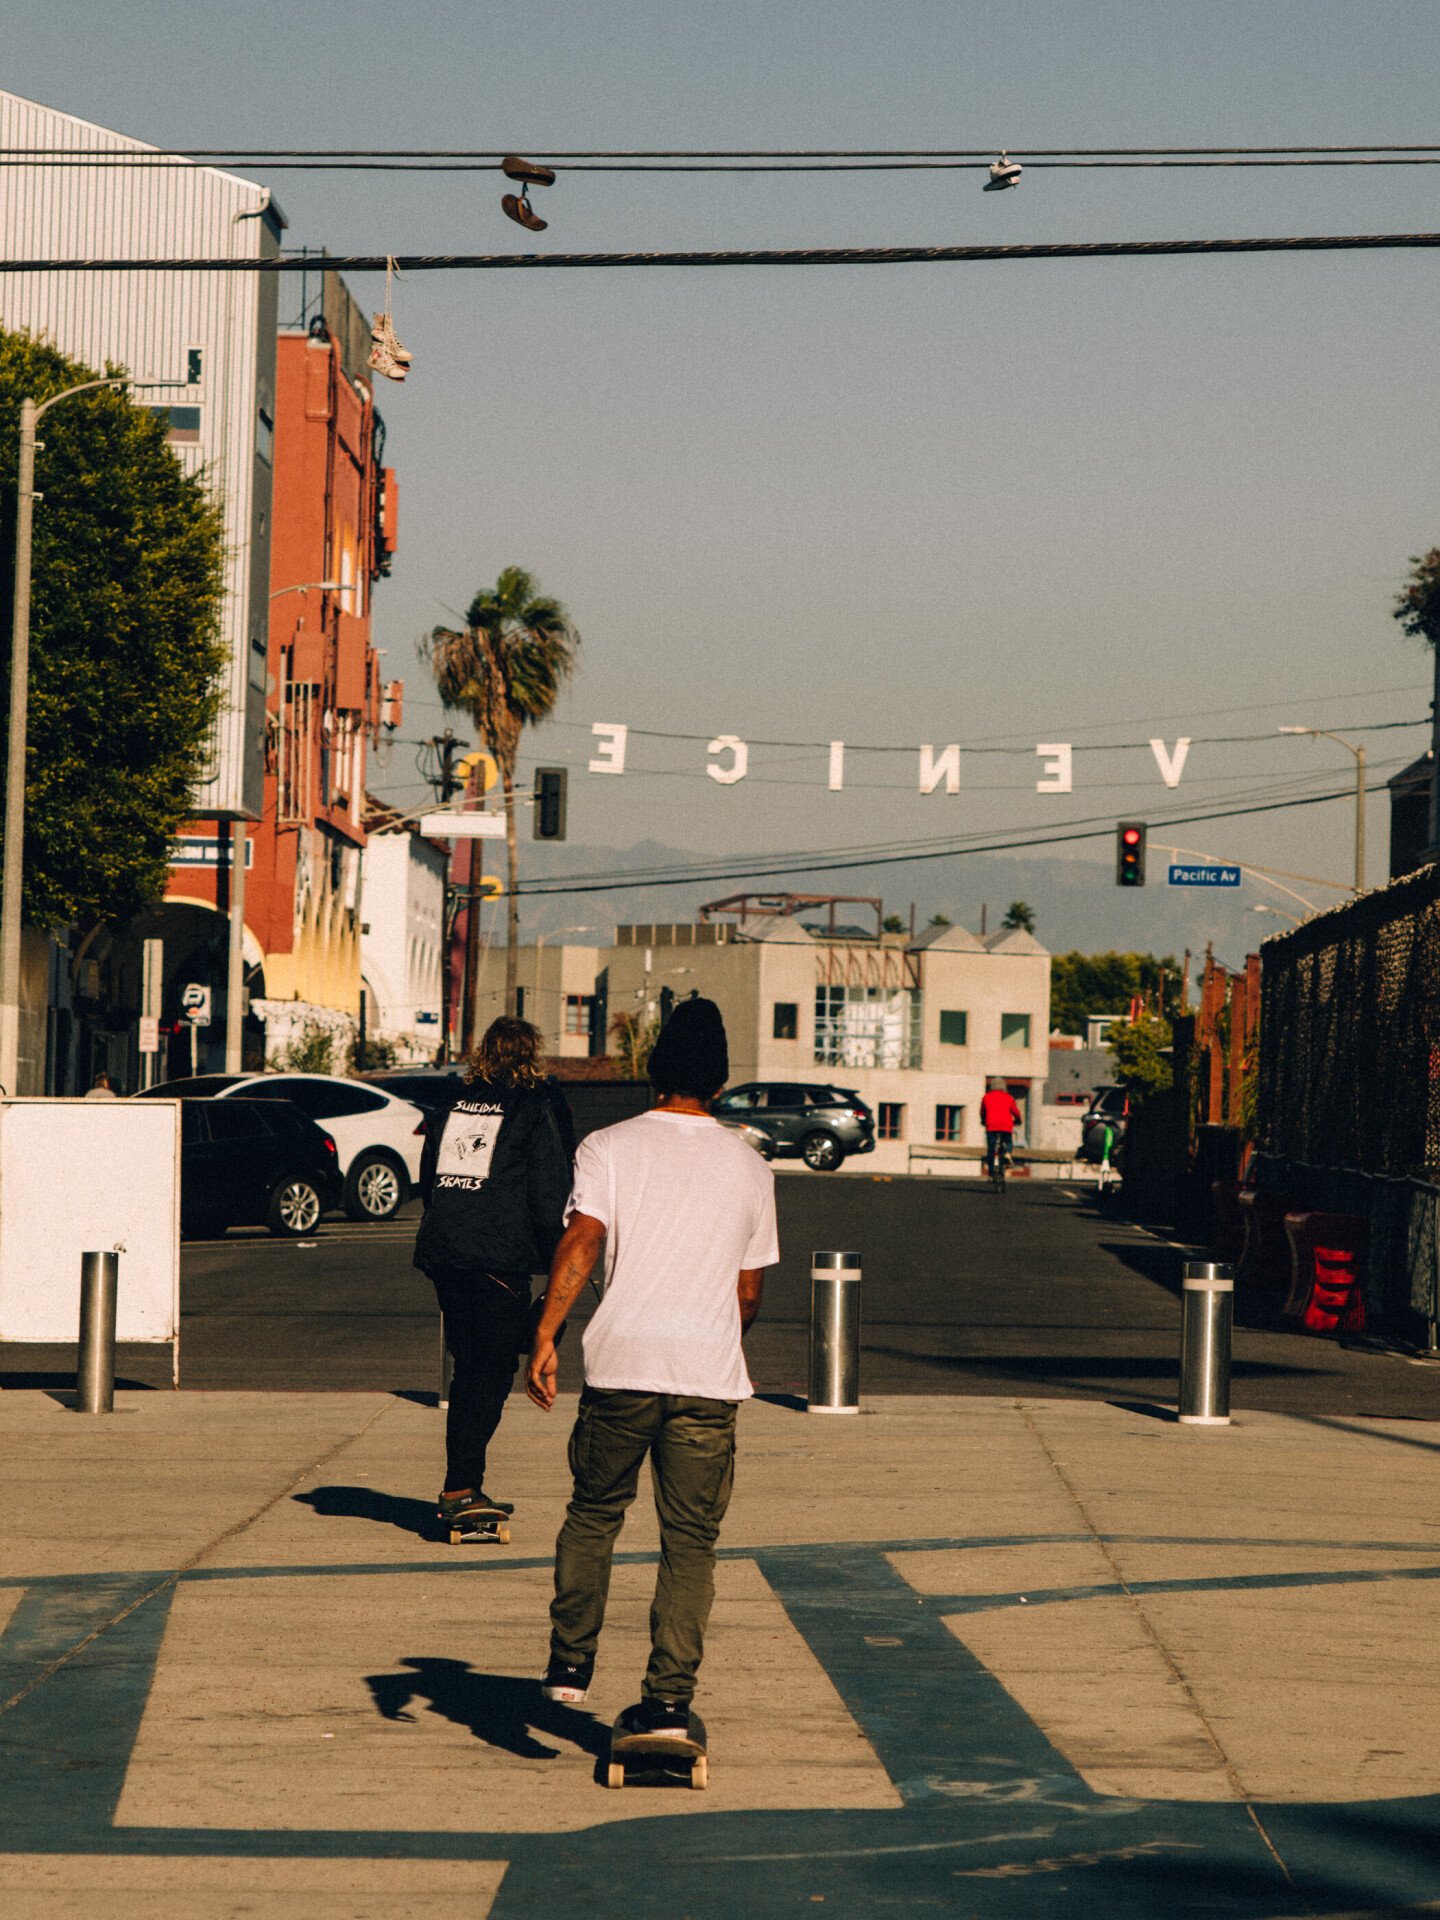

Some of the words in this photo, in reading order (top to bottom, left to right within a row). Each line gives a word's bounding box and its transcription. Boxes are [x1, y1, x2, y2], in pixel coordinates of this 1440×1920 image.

[1173, 869, 1217, 881] Pacific
[1221, 870, 1236, 881] Av
[452, 1100, 504, 1113] SUICIDAL
[437, 1176, 484, 1190] SKATES
